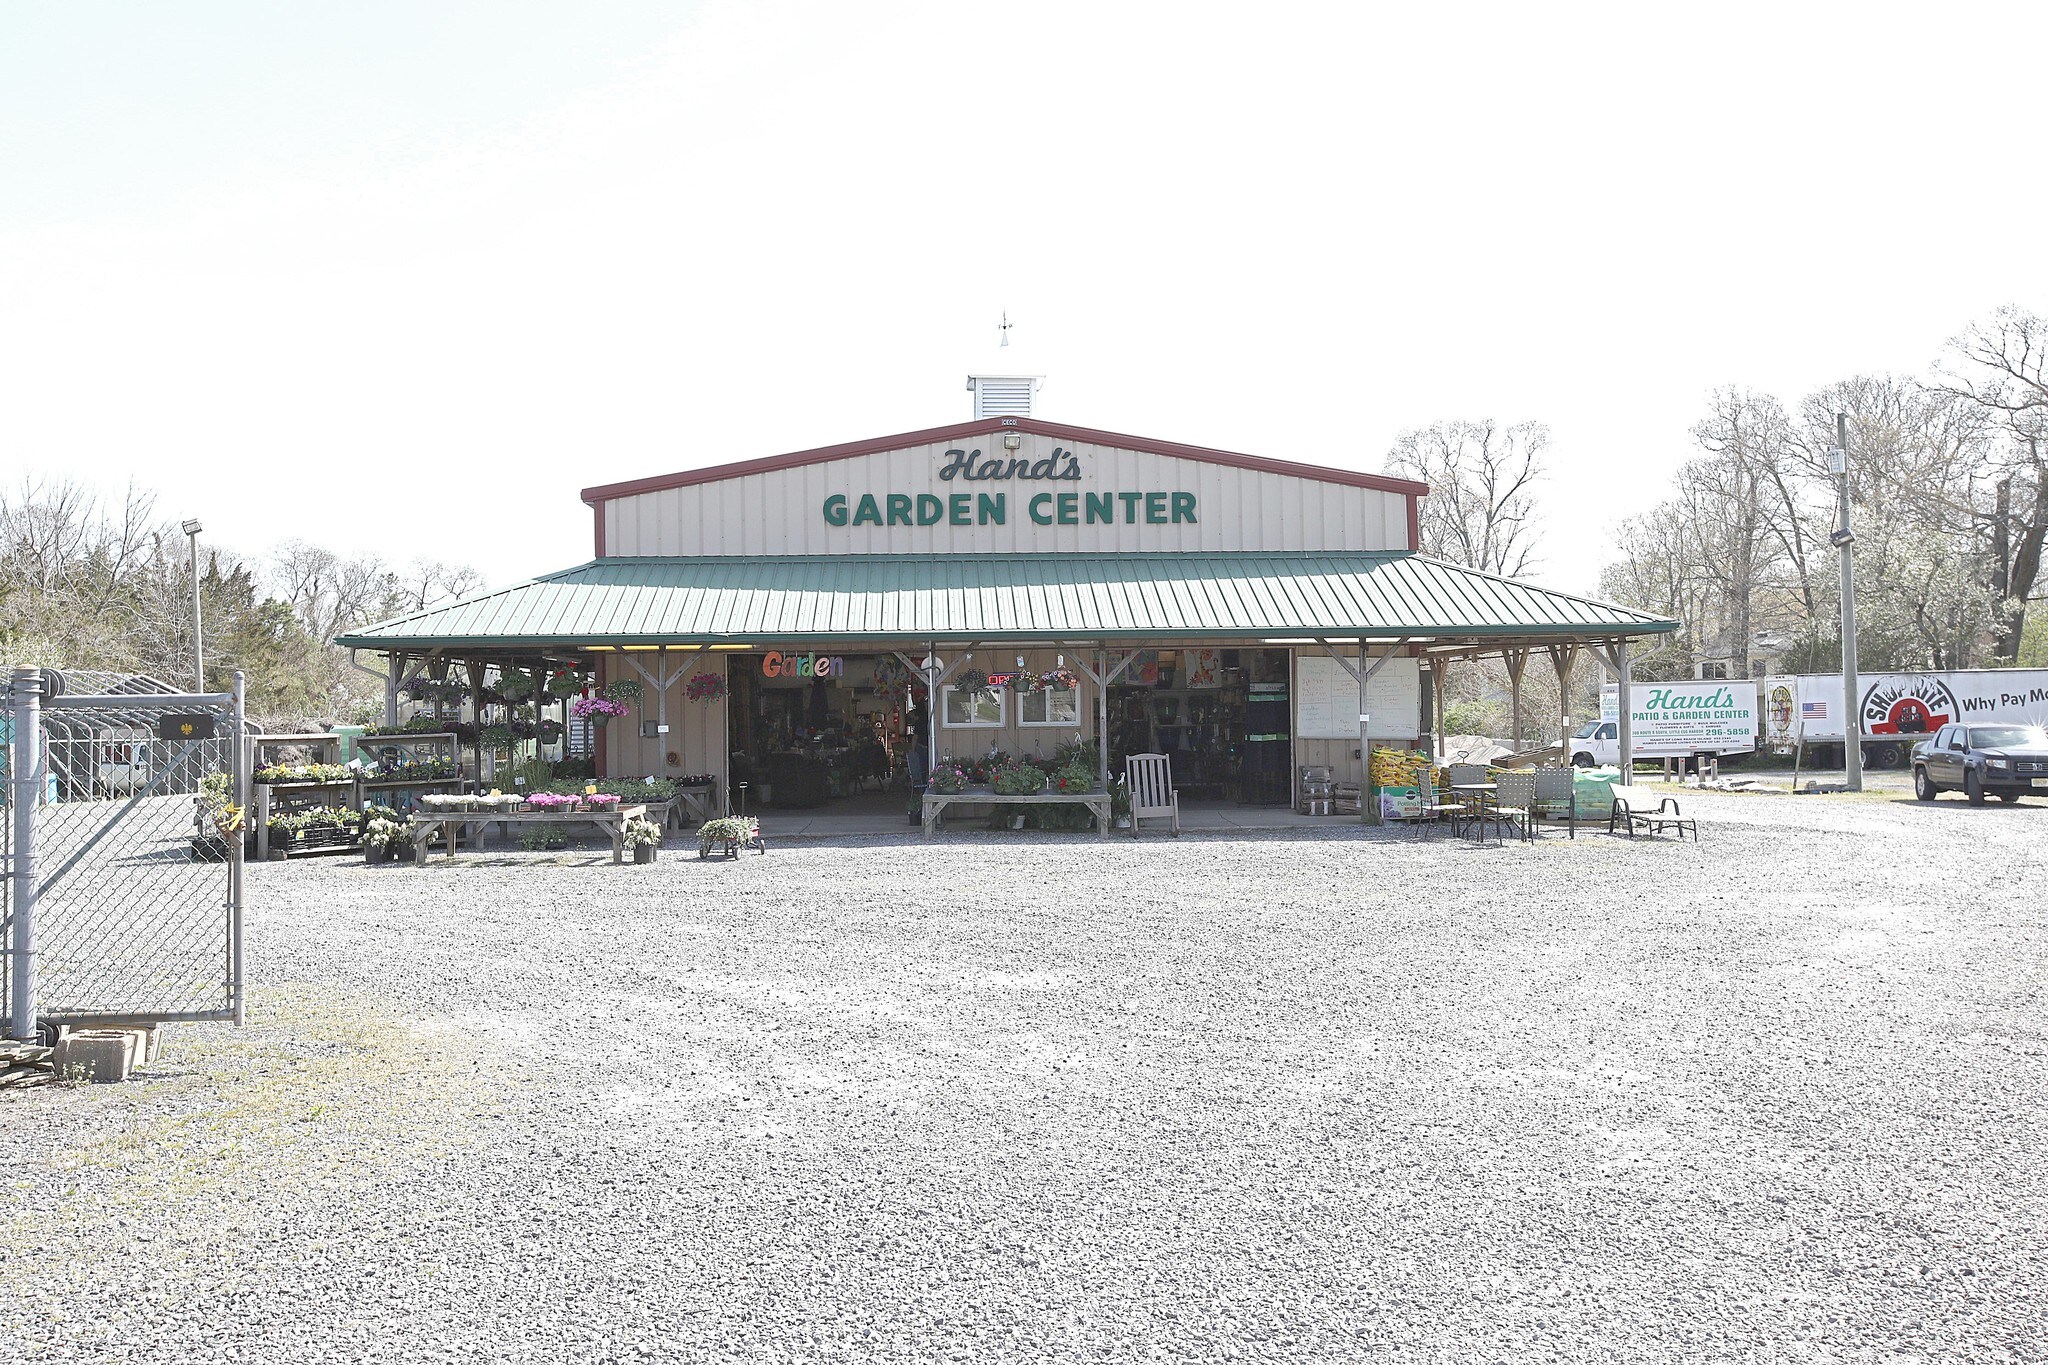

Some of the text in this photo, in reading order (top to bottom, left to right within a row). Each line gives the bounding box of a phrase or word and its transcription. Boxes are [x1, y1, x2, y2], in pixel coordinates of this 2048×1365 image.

[939, 447, 1082, 481] Hand's
[823, 491, 1198, 526] GARDEN CENTER
[762, 651, 844, 678] Garden
[1646, 687, 1734, 709] Hand's
[1963, 697, 1996, 712] Why
[2000, 693, 2027, 706] Pay
[1632, 710, 1750, 721] PATIO & GARDEN CENTER
[1705, 728, 1750, 736] 296-5858
